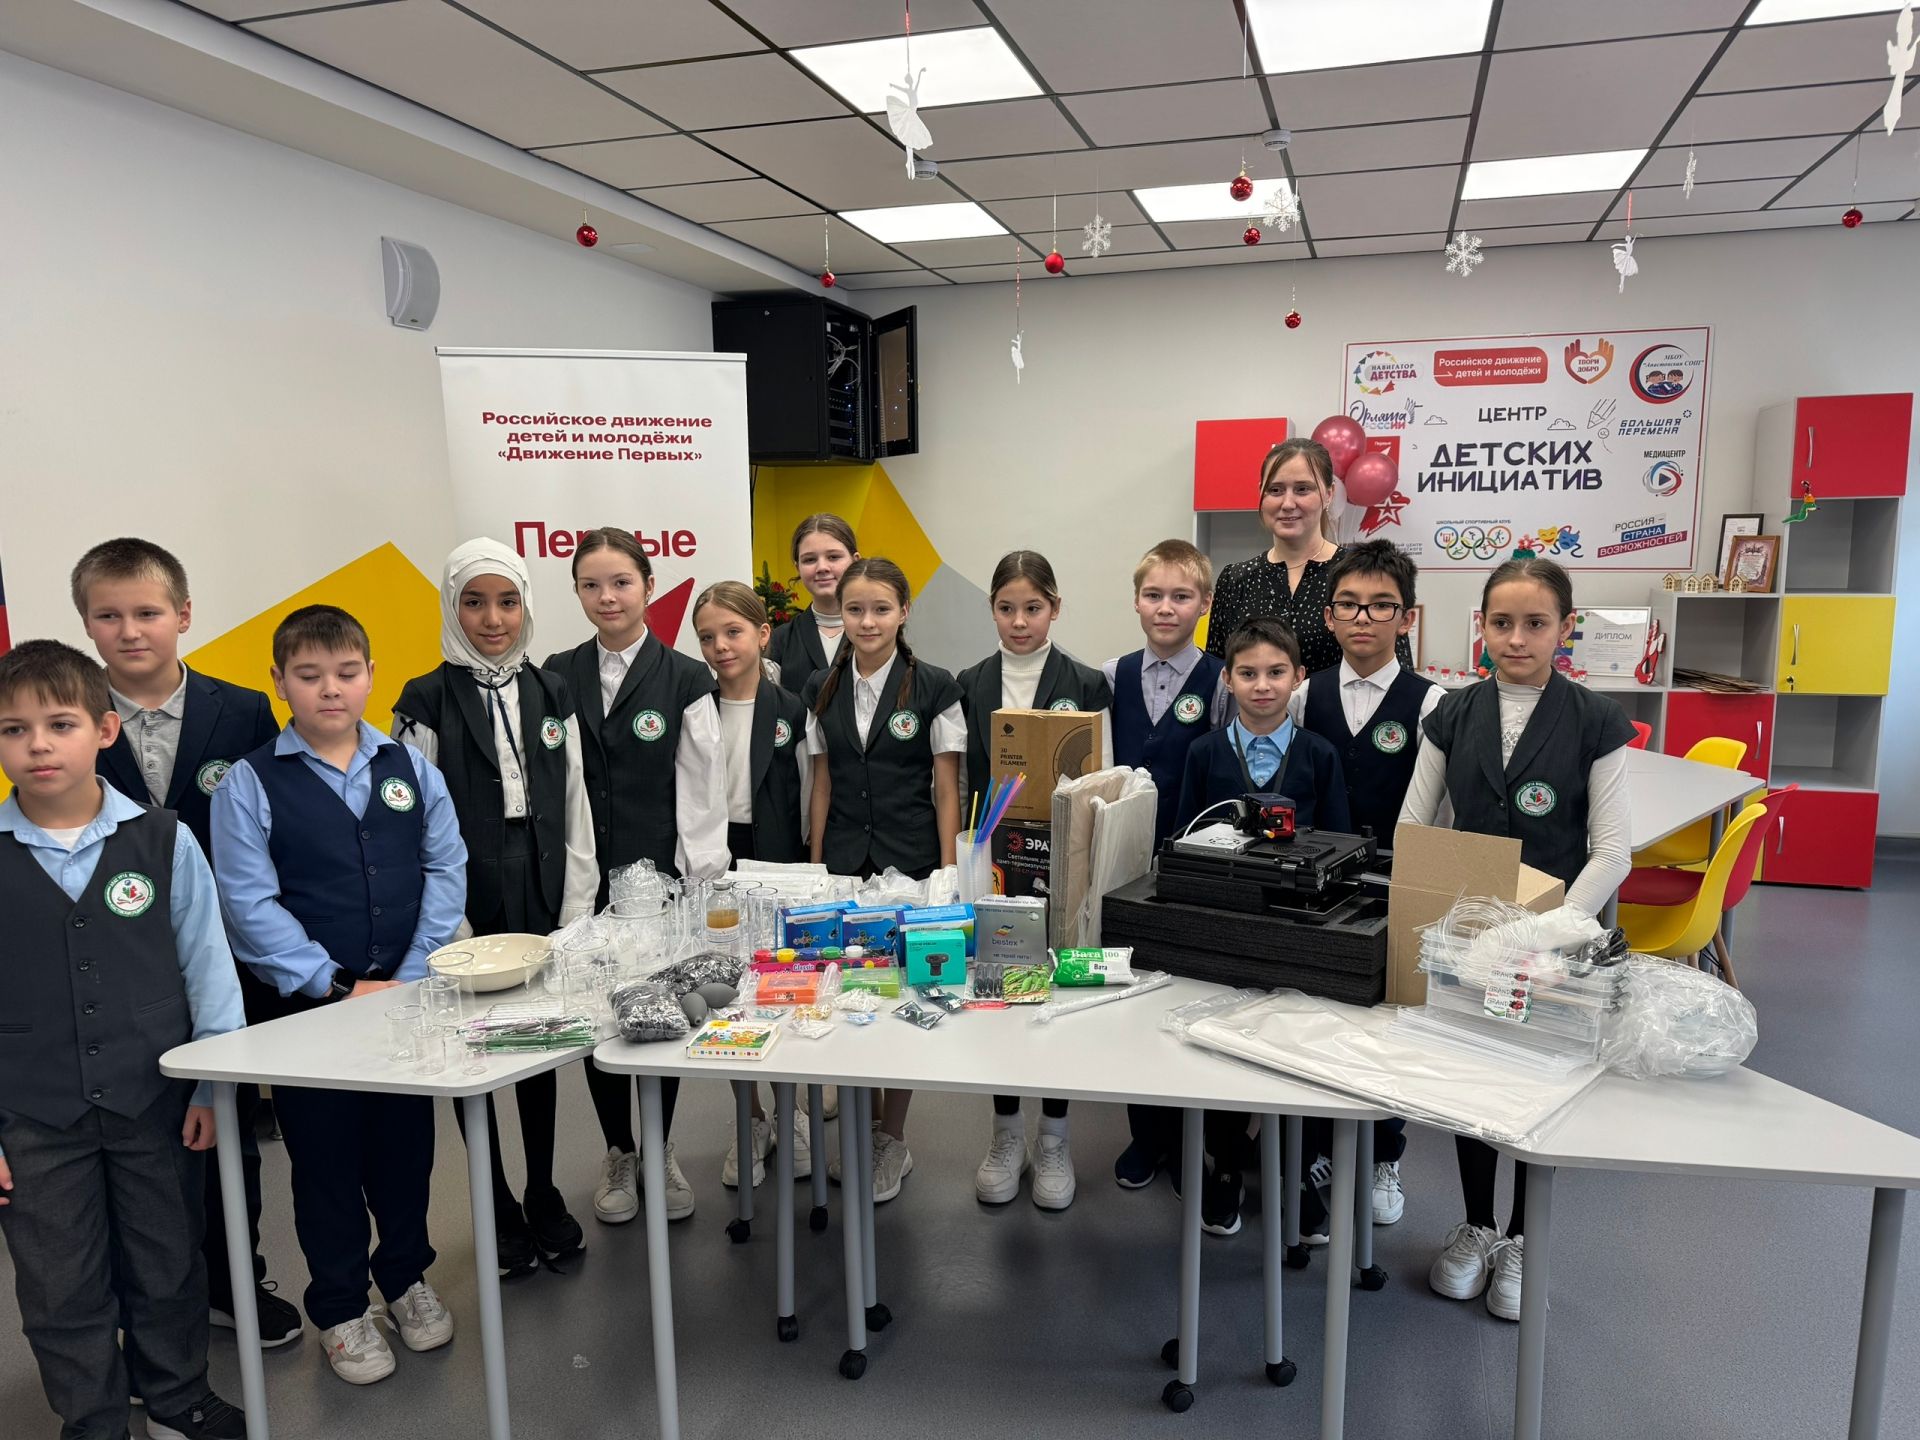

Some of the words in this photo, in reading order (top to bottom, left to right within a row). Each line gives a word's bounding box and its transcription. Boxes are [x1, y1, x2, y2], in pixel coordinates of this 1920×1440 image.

[1439, 358, 1493, 367] Российское
[1495, 356, 1541, 366] движение
[1370, 370, 1417, 381] ДЕТСТВА
[1455, 368, 1482, 378] детей
[1493, 366, 1541, 376] молодёжи
[482, 412, 607, 426] Российское
[611, 416, 712, 428] движение
[1350, 400, 1407, 426] Орлята
[1478, 406, 1547, 423] ЦЕНТР
[1620, 418, 1681, 427] БОЛЬШАЯ
[506, 430, 568, 444] детей
[571, 432, 584, 442] и
[588, 431, 693, 445] молодёжи
[1618, 427, 1679, 436] ПЕРЕМЕНА
[498, 446, 614, 461] «Движение
[618, 448, 702, 462] Первых»
[1430, 440, 1593, 468] ДЕТСКИХ
[1644, 450, 1686, 458] МЕДИАЦЕНТР
[1418, 469, 1602, 493] ИНИЦИАТИВ
[1615, 517, 1655, 532] РОССИЯ
[514, 522, 697, 558] Пеые
[1623, 527, 1662, 541] СТРАНА
[1600, 532, 1683, 556] ВОЗМОЖНОСТЕЙ
[1594, 632, 1632, 641] ДИПЛОМ
[1025, 838, 1050, 852] ЭРА
[1071, 950, 1101, 958] Вата
[793, 963, 814, 971] Classic
